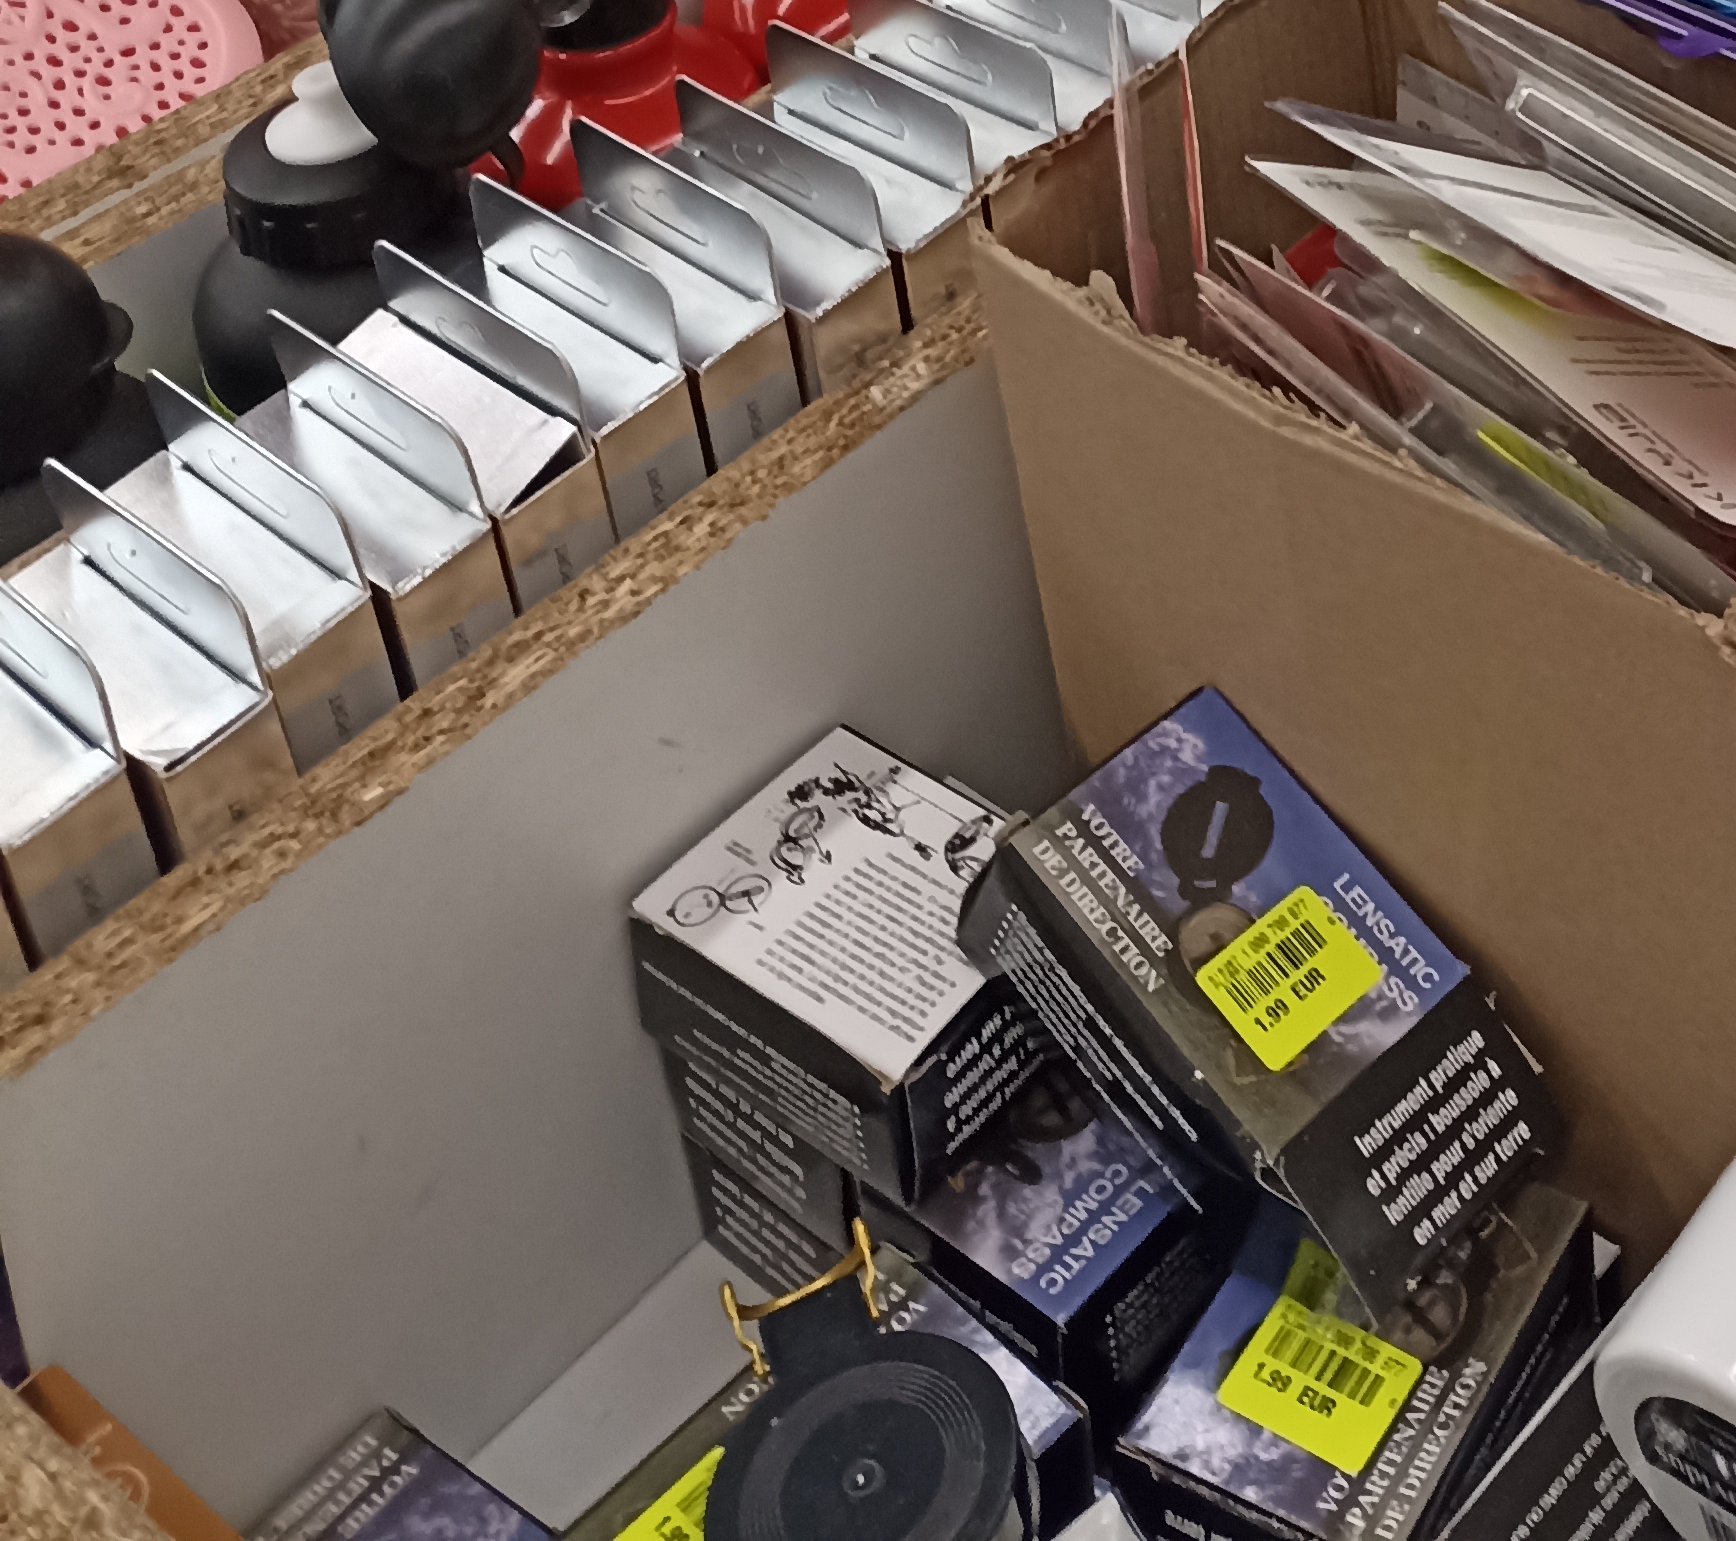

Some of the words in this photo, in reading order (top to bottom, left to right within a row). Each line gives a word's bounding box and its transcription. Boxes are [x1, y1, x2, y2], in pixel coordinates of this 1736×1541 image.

[1054, 820, 1174, 958] PARTENAIRE
[1081, 803, 1145, 877] VOTRE
[1032, 839, 1069, 876] DE
[1058, 870, 1166, 993] DIRECTION
[1333, 872, 1440, 989] LENSATIC
[1253, 997, 1291, 1033] 1.99
[1289, 966, 1328, 1002] EUR
[1353, 1076, 1434, 1158] Instrument
[1428, 1029, 1486, 1094] pratique
[1427, 1069, 1491, 1135] boussole
[1430, 1138, 1466, 1186] pour
[1473, 1151, 1499, 1185] sur
[1011, 1163, 1130, 1280] COMPASS
[1039, 1179, 1154, 1295] LENSATIC
[1296, 1384, 1338, 1419] EUR
[1345, 1365, 1450, 1530] PARTENAIRE
